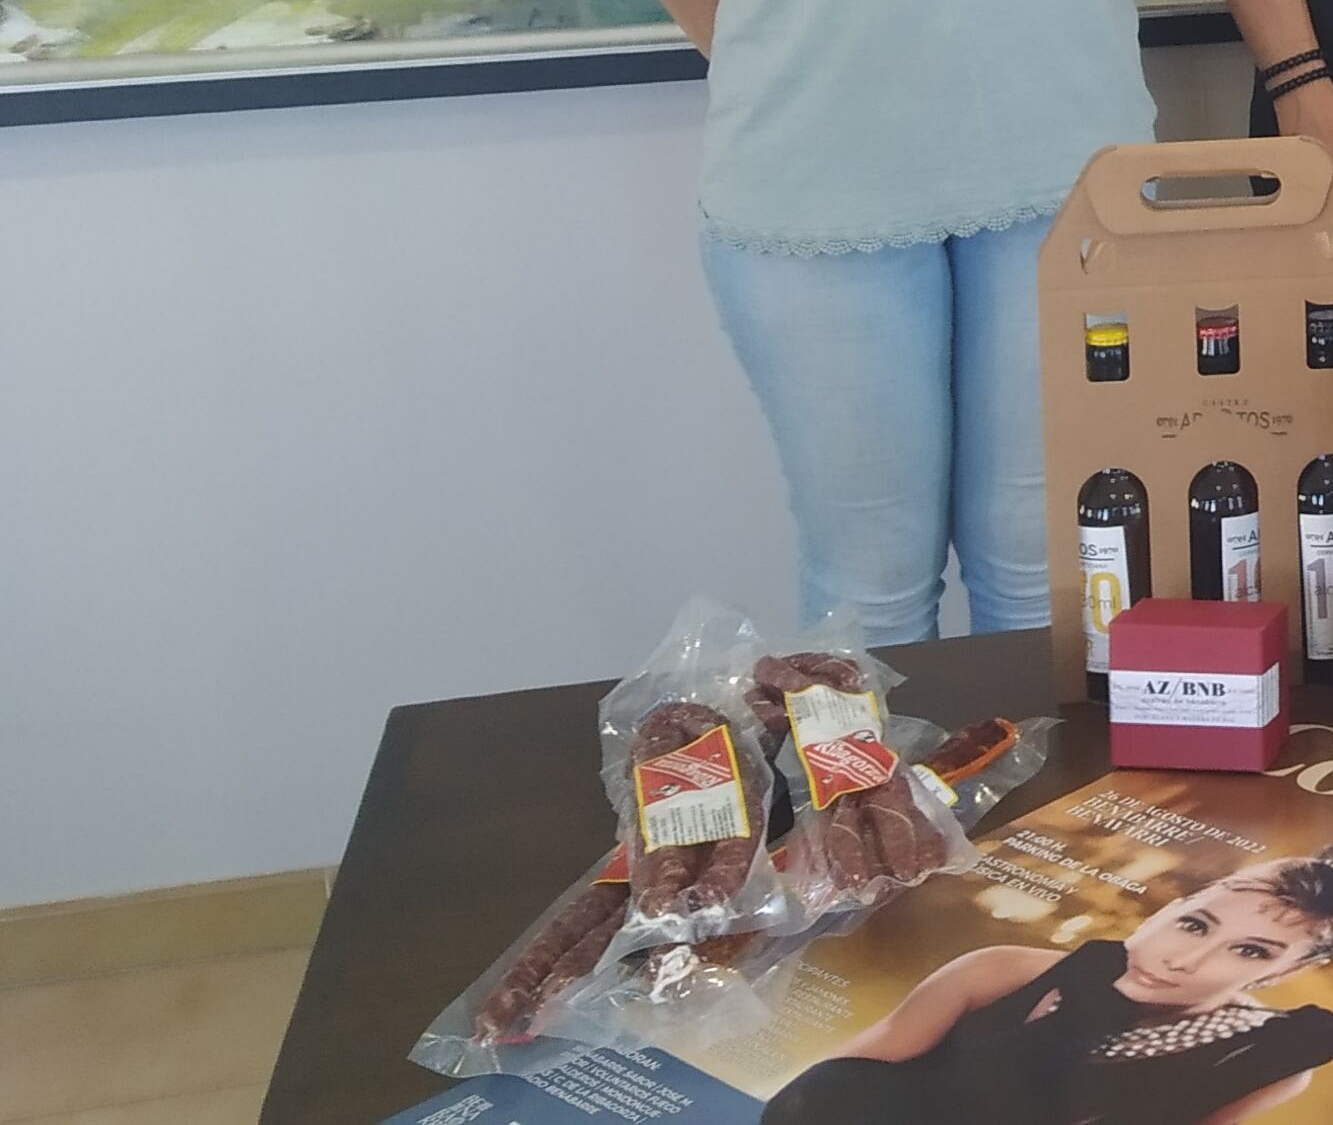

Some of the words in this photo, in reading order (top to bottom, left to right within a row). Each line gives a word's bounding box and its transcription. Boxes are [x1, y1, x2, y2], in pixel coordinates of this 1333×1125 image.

[1143, 677, 1227, 698] AZ/BNB
[1065, 805, 1170, 847] BENAVARRI
[1082, 796, 1194, 843] BENABARRE
[1143, 805, 1206, 832] AGOSTO
[1204, 827, 1232, 841] DE
[1226, 836, 1266, 854] 2022
[982, 856, 1068, 891] ASTRONOMÍA
[1001, 837, 1062, 863] PARKING
[1058, 857, 1082, 871] DE
[1079, 865, 1100, 877] LA
[1098, 871, 1148, 895] OBAGA
[1006, 876, 1028, 890] EN
[1027, 882, 1063, 903] VIVO
